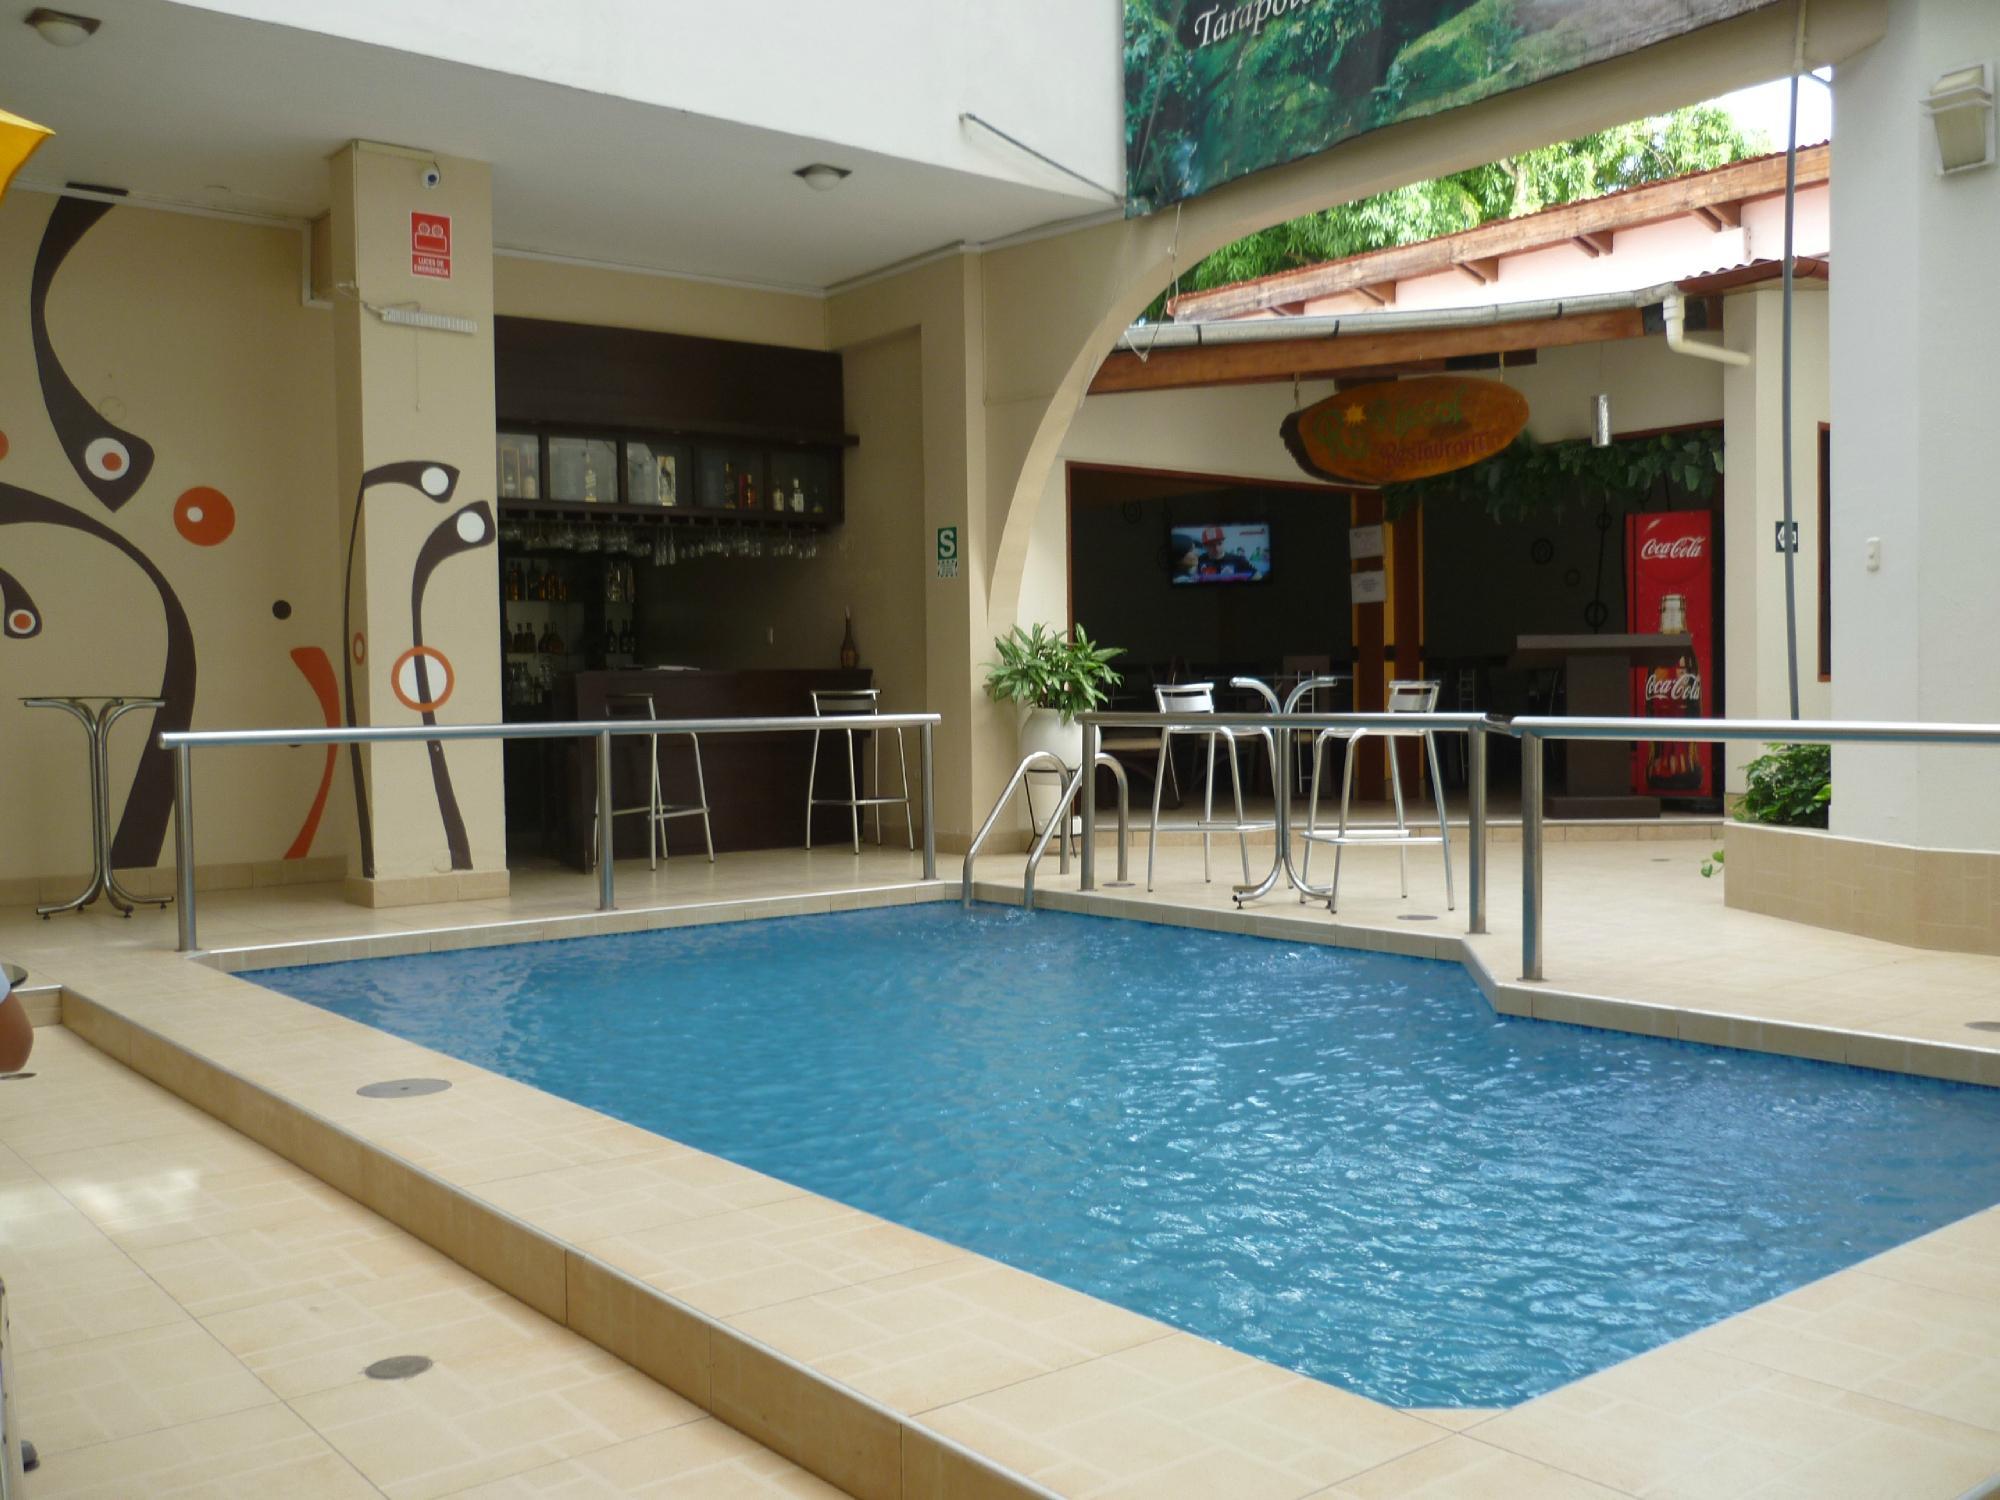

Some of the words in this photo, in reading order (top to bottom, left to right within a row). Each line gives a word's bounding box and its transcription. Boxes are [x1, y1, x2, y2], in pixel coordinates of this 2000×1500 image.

[1194, 0, 1310, 47] Tarapo
[940, 530, 955, 557] S
[1641, 536, 1705, 559] Coca-Cola
